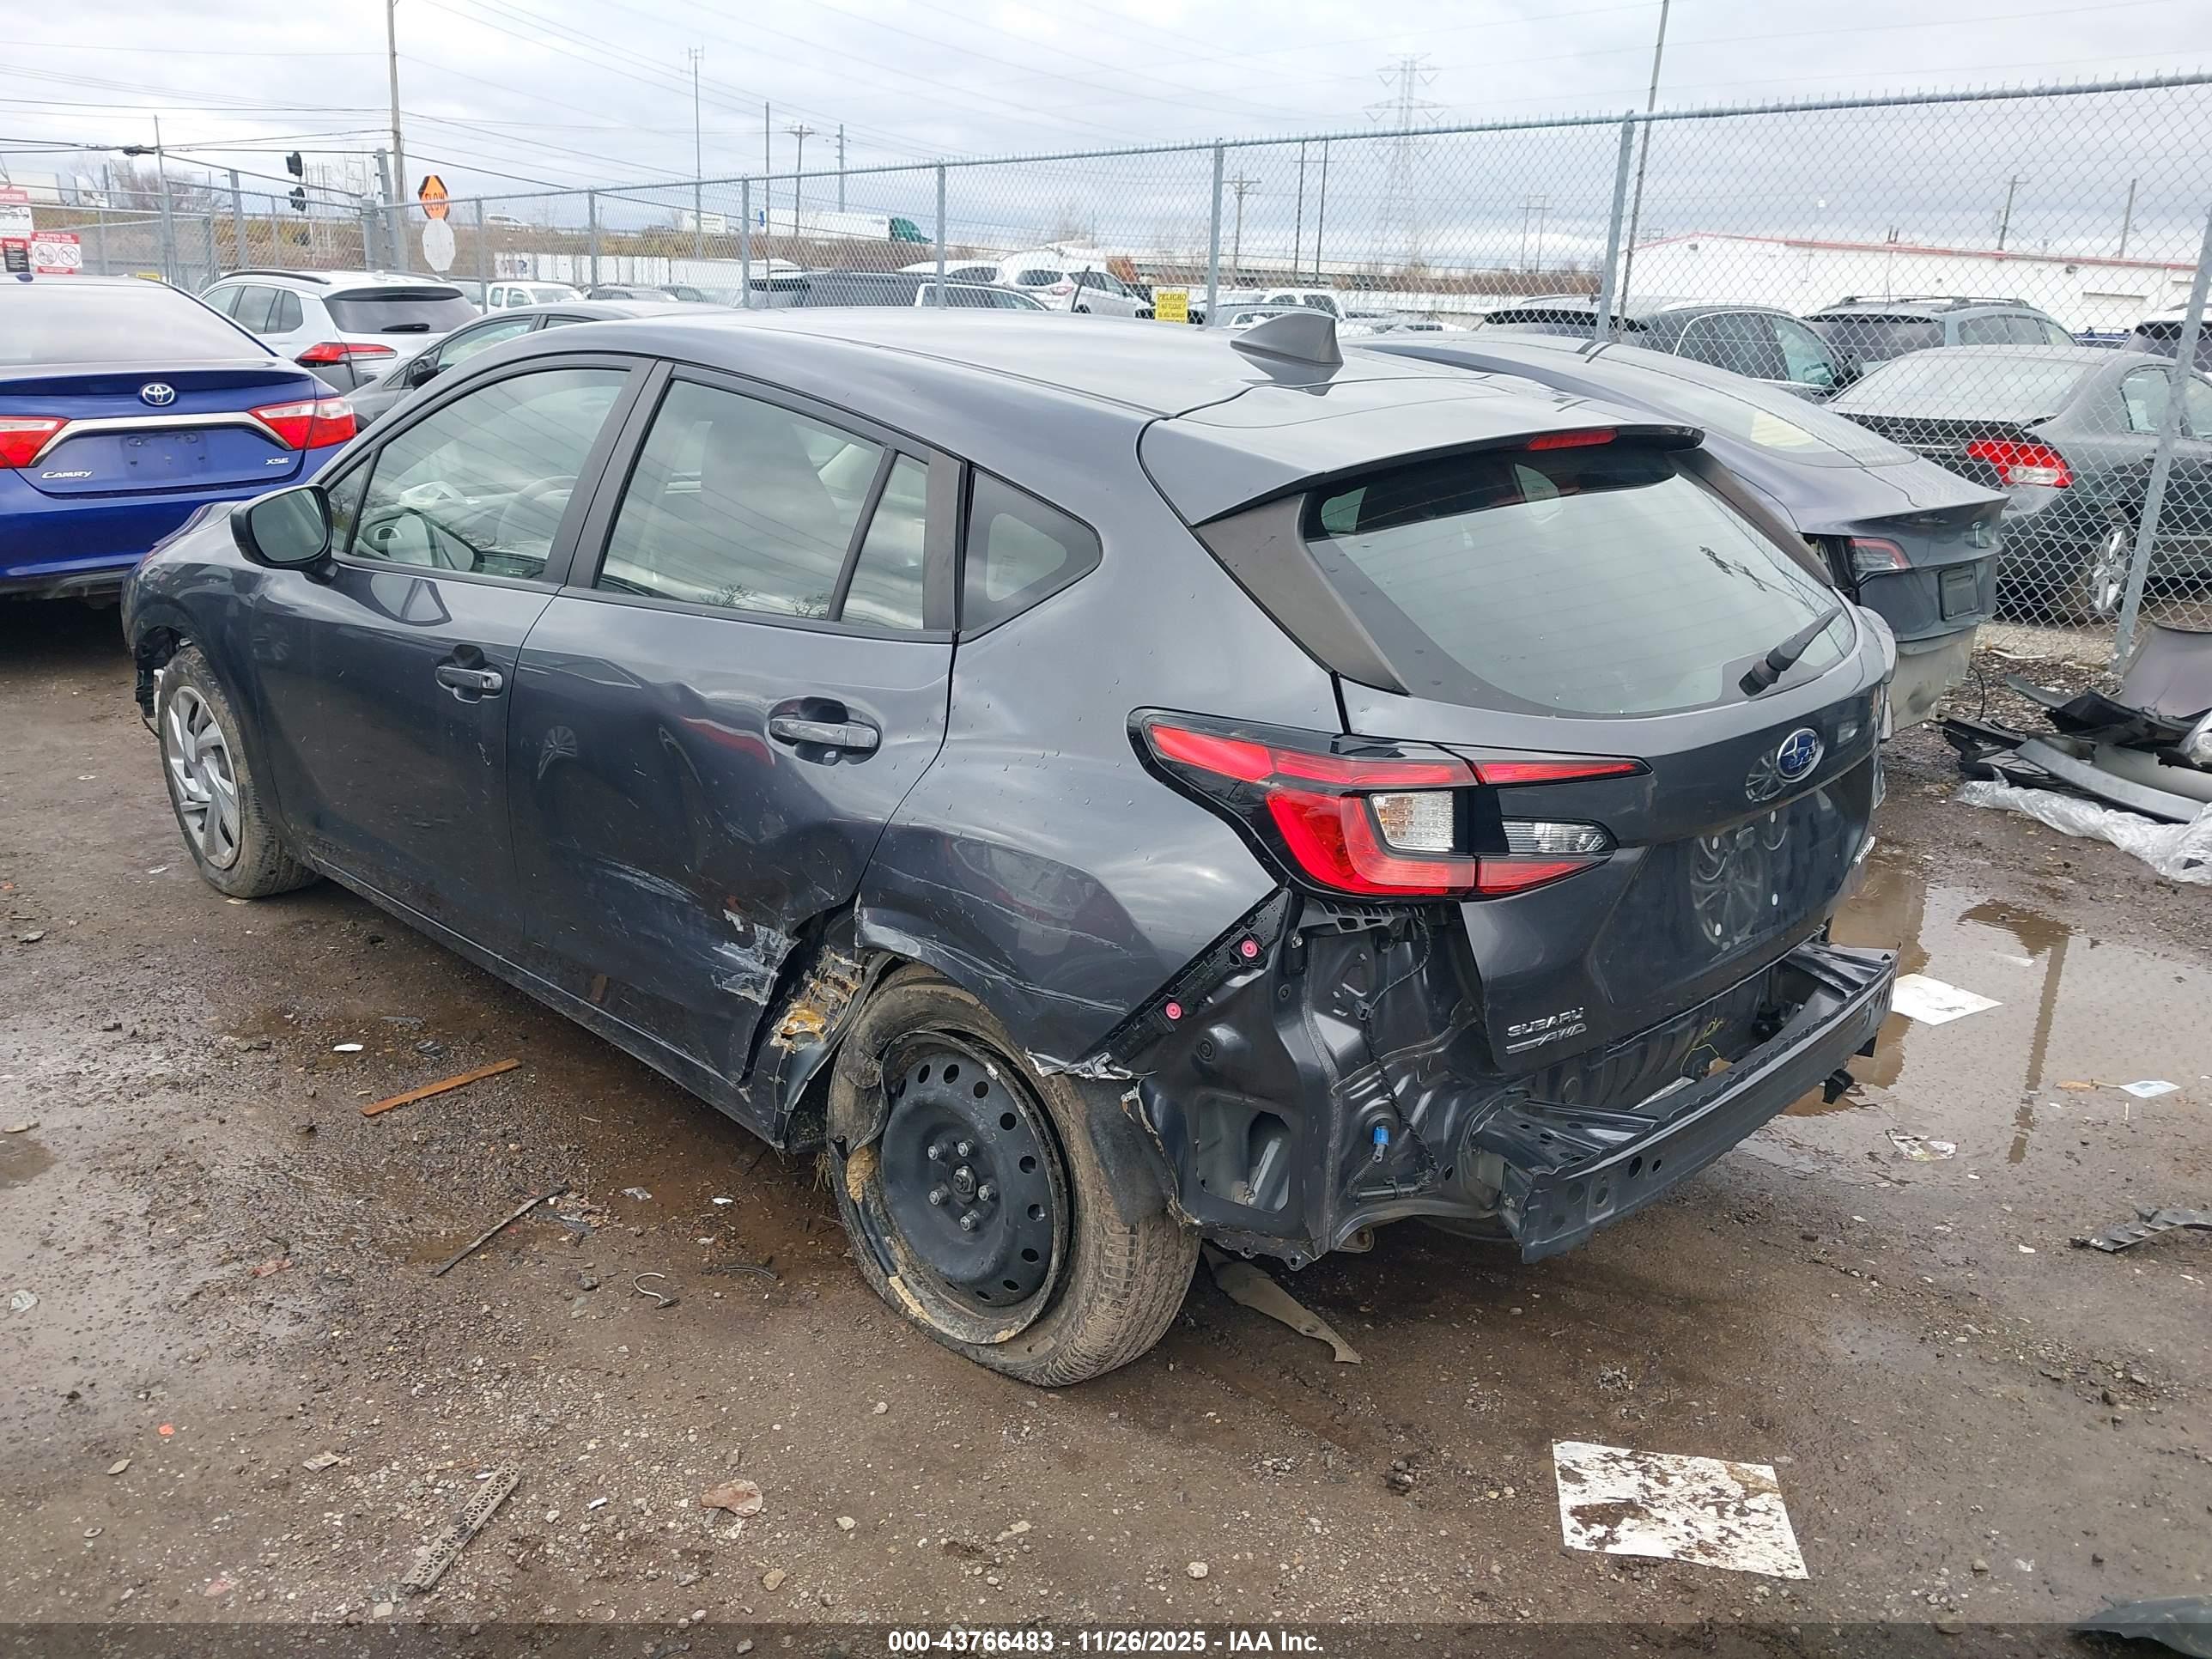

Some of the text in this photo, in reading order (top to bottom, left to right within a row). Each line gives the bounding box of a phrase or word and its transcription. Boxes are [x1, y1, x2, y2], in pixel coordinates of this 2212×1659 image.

[265, 457, 289, 465] XSE
[41, 471, 93, 479] CAMRY
[1506, 1006, 1584, 1038] SUBARU
